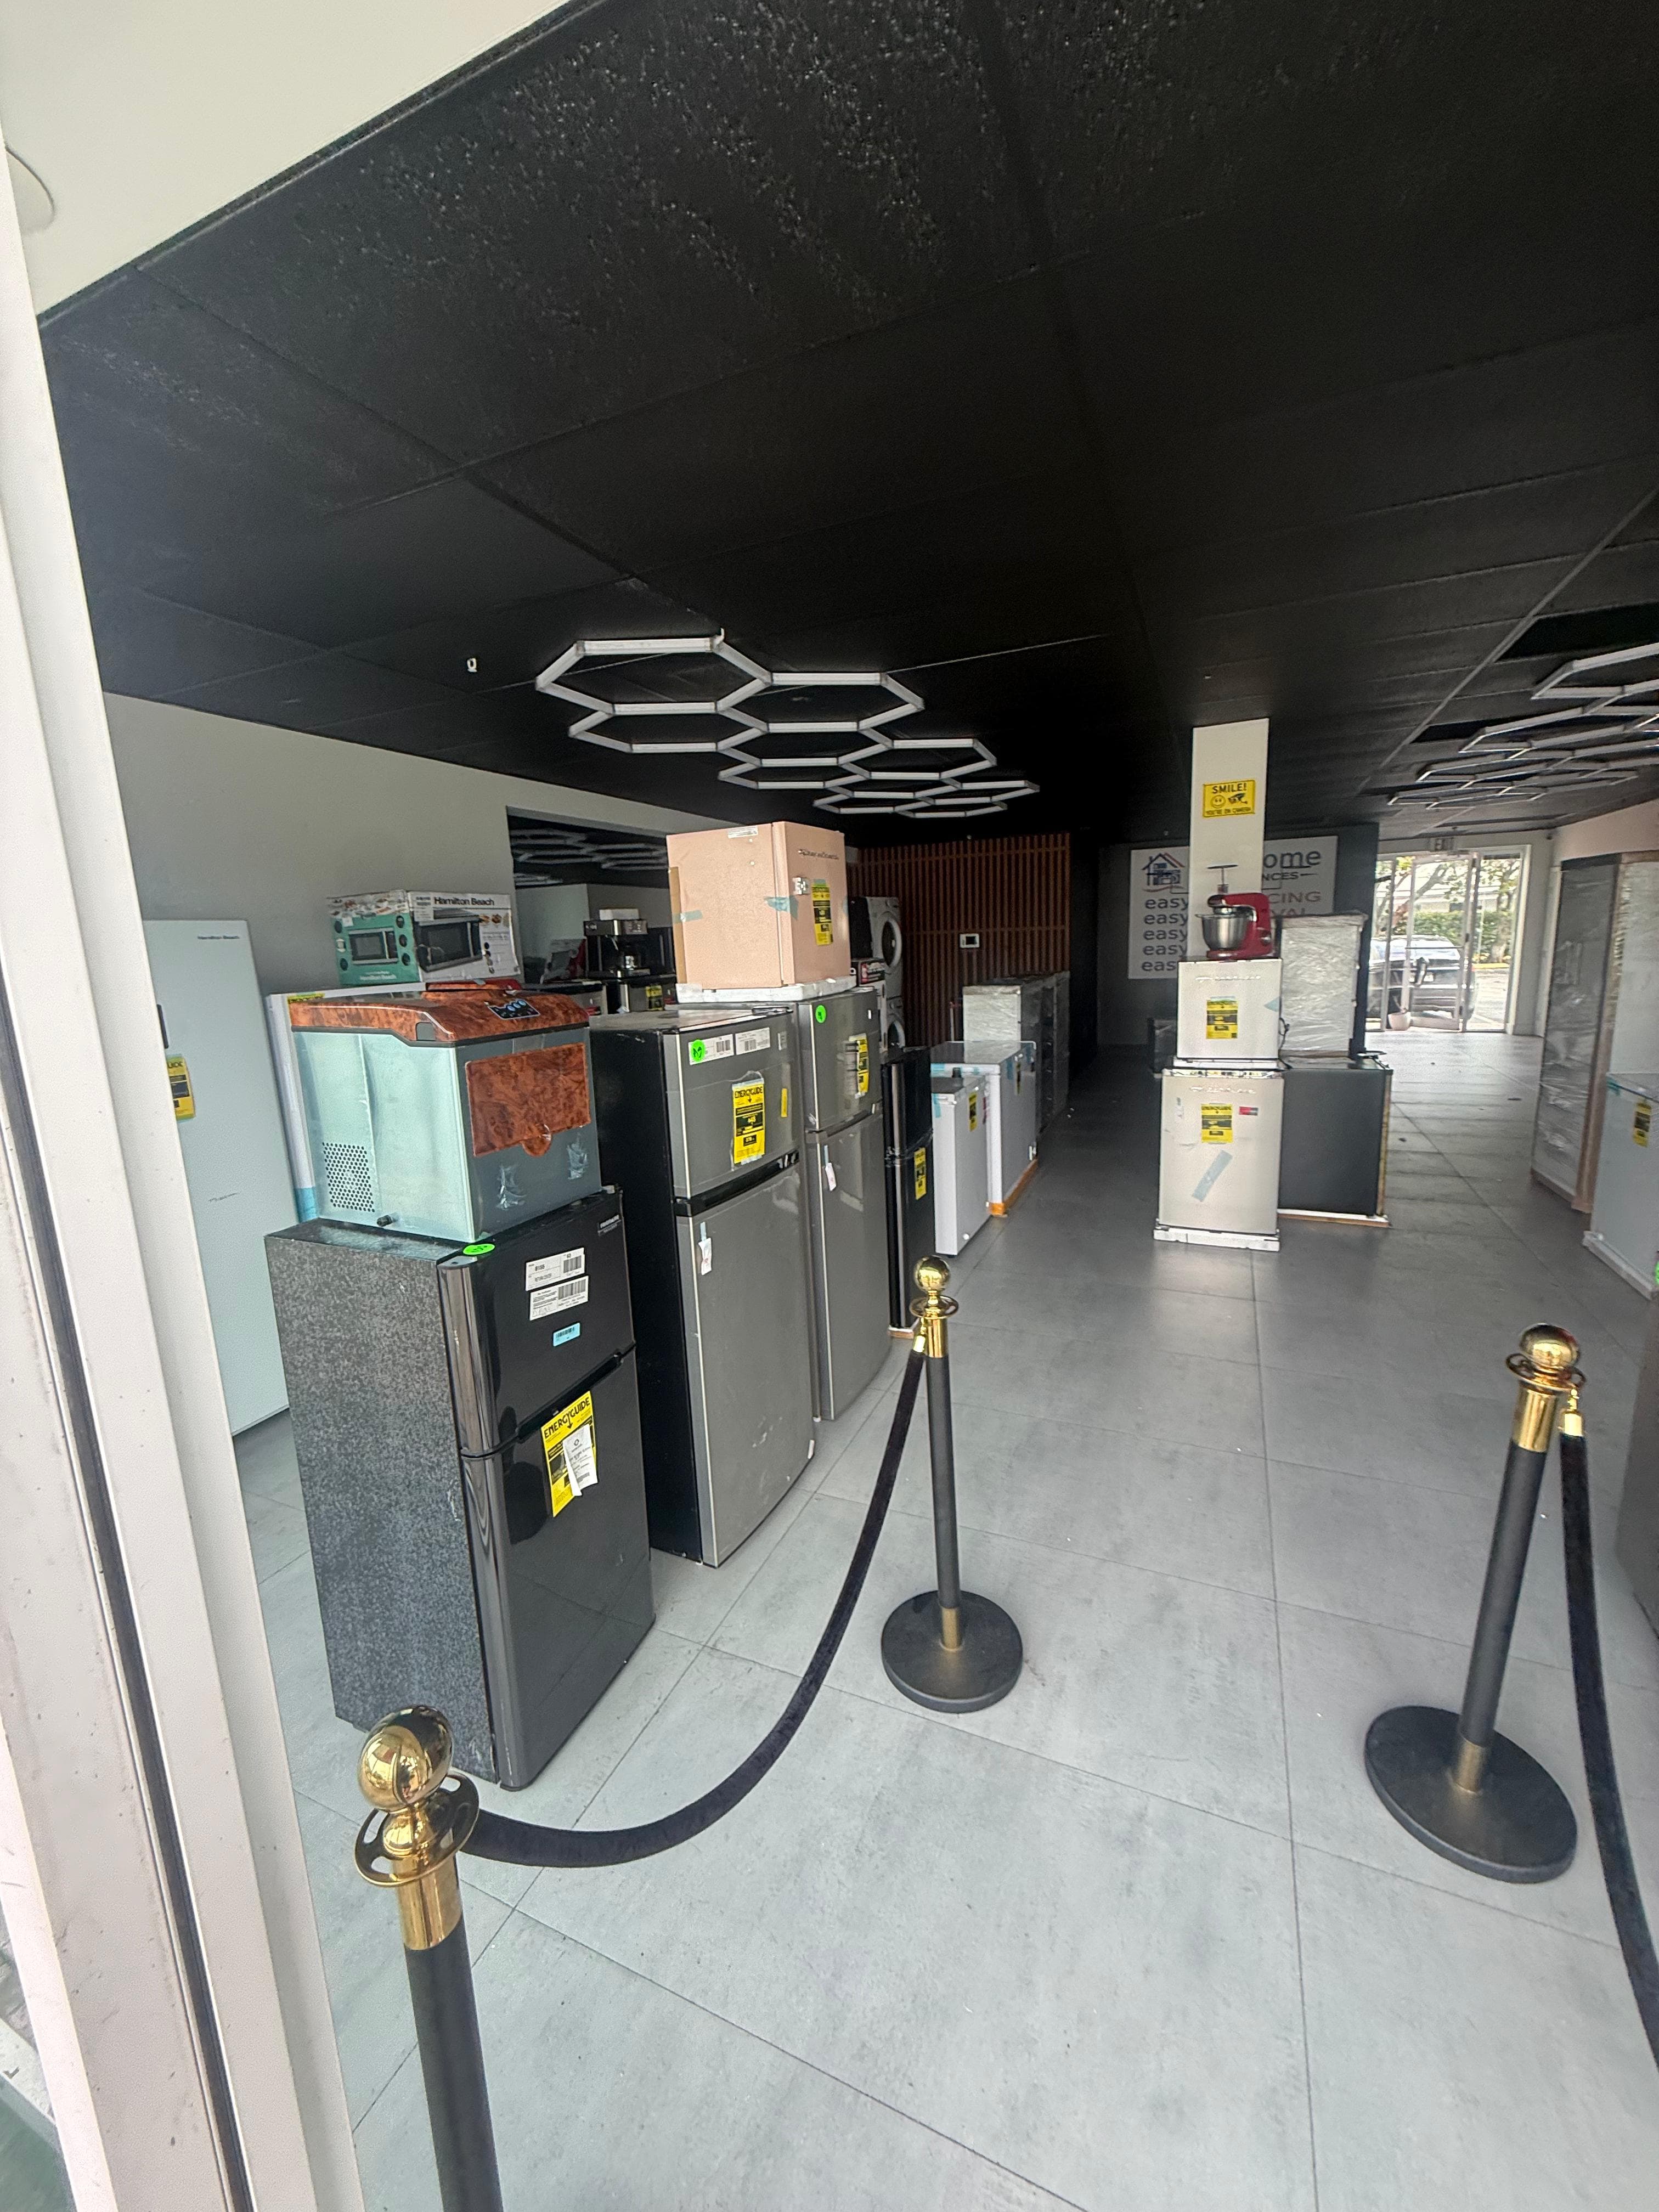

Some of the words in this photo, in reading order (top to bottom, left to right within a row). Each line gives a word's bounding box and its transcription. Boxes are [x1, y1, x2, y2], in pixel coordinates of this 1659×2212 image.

[1212, 782, 1247, 794] SMILE!
[1263, 851, 1321, 868] ome
[1262, 871, 1299, 881] NCES
[434, 896, 470, 905] Hamilton
[1268, 891, 1321, 904] CING
[1145, 898, 1189, 911] easy
[1144, 913, 1188, 927] easy
[1143, 929, 1187, 942] easy
[1143, 944, 1187, 958] easy
[1141, 961, 1177, 972] eas
[544, 1397, 590, 1438] ENERGYGUIDE
